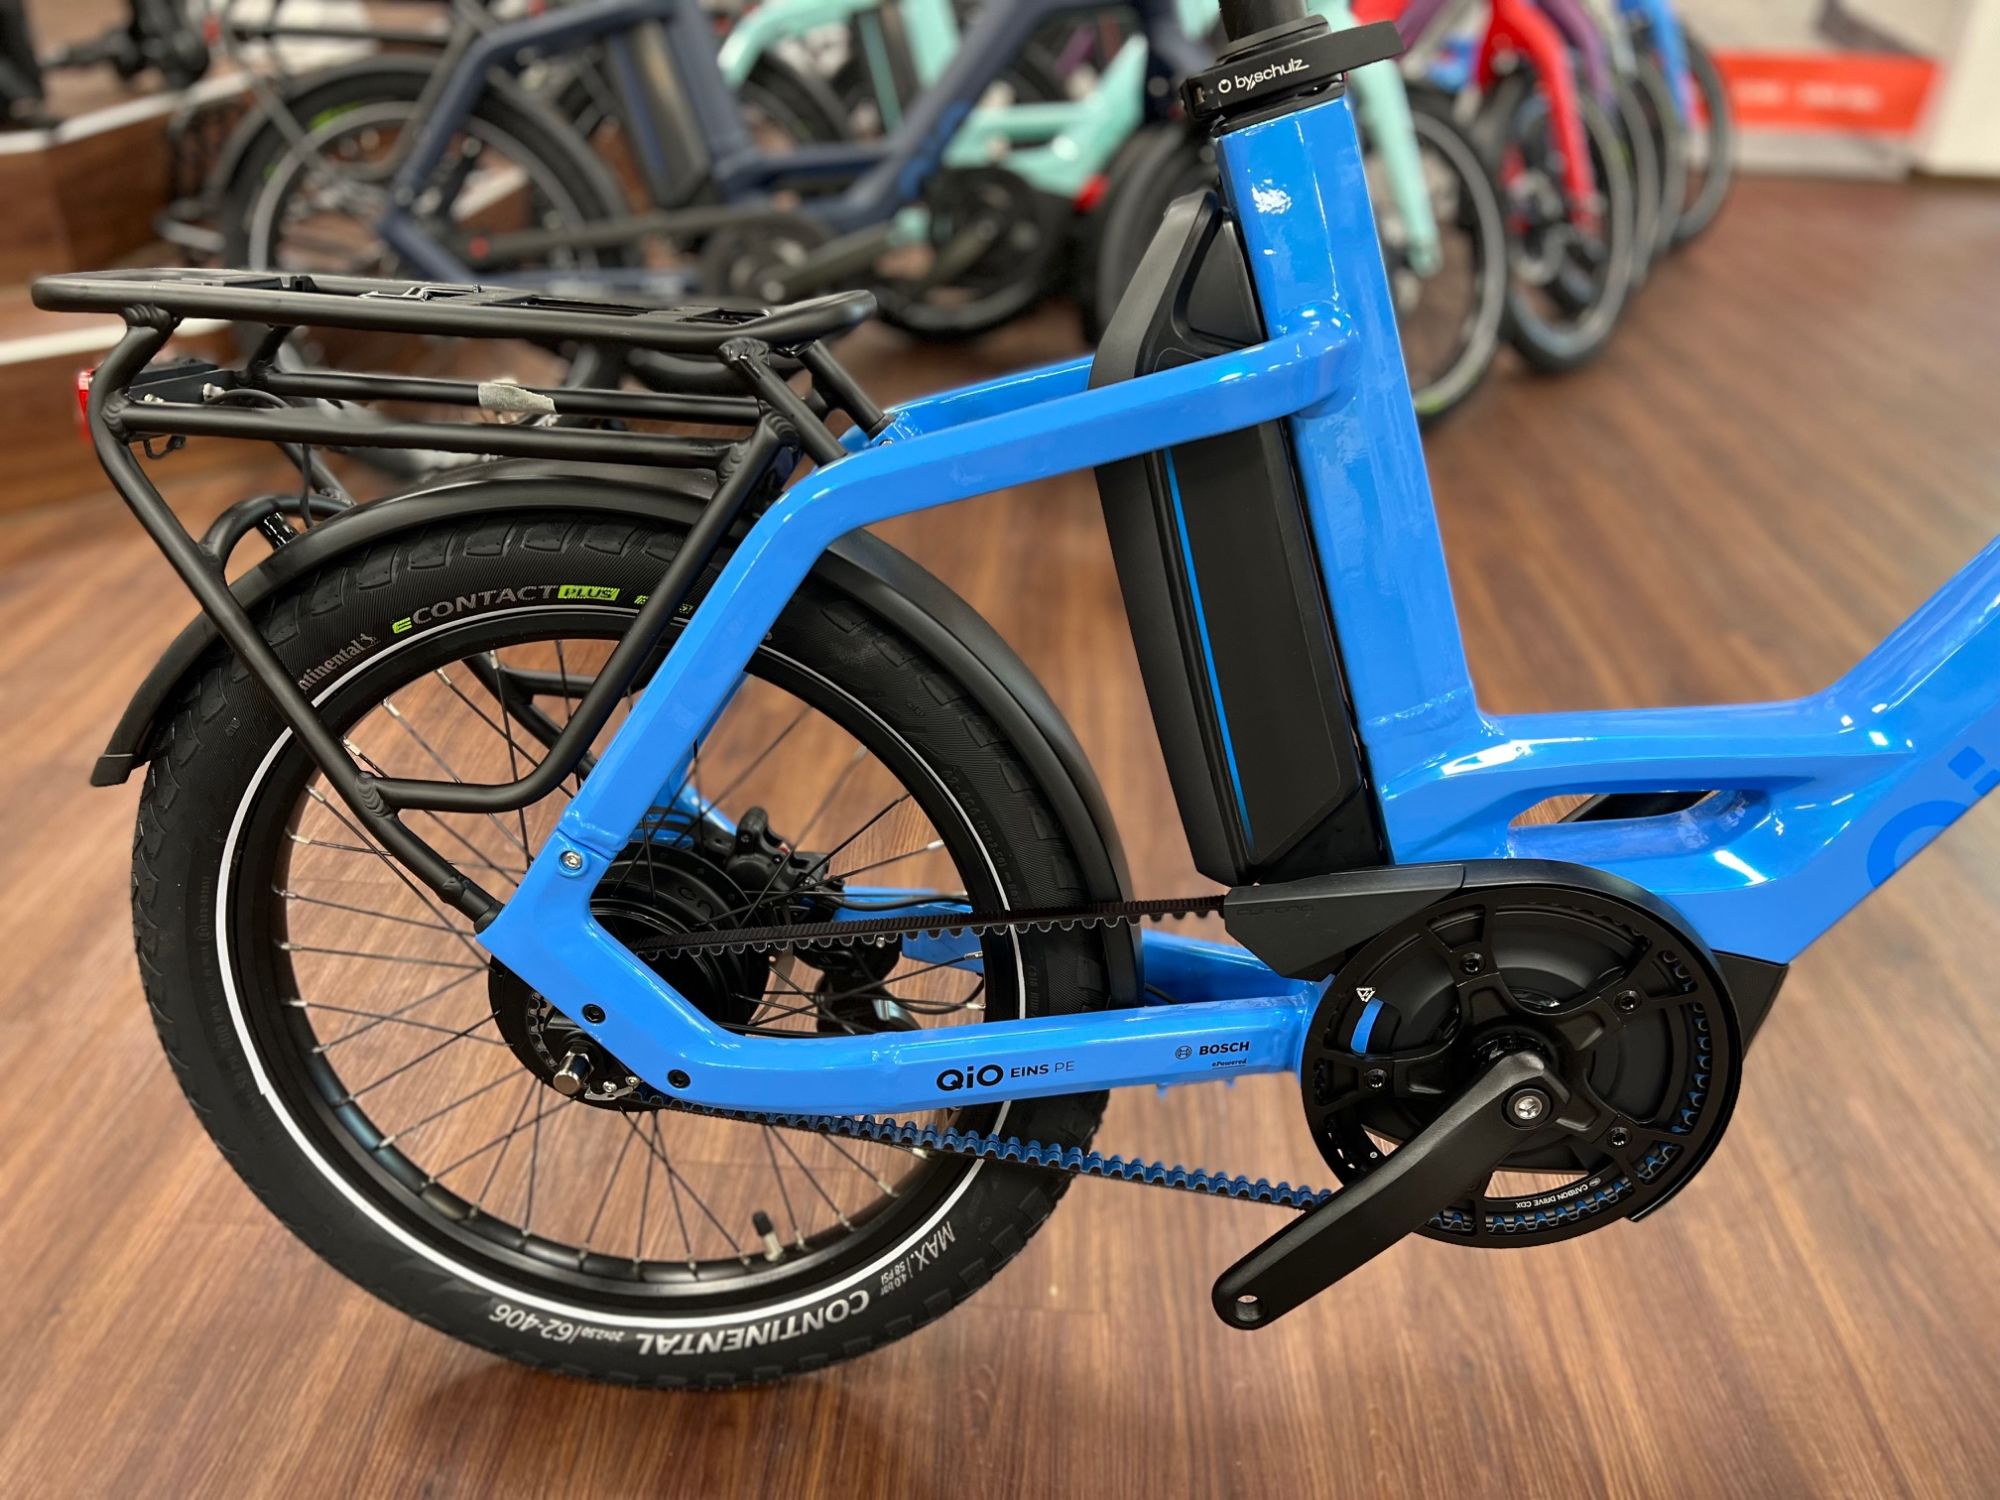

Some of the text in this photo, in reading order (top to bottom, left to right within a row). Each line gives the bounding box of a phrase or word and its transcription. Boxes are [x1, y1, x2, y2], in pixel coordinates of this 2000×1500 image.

[561, 586, 617, 600] PLUS
[298, 639, 366, 692] ntinental
[1199, 1040, 1250, 1056] BOSCH
[936, 1060, 1076, 1091] QiO EINS PE
[1557, 1184, 1588, 1200] CARBON
[1534, 1195, 1557, 1206] DRIVE
[881, 1261, 906, 1286] 58 PSI
[880, 1281, 894, 1296] bar
[636, 1289, 870, 1355] CONTINENTAL
